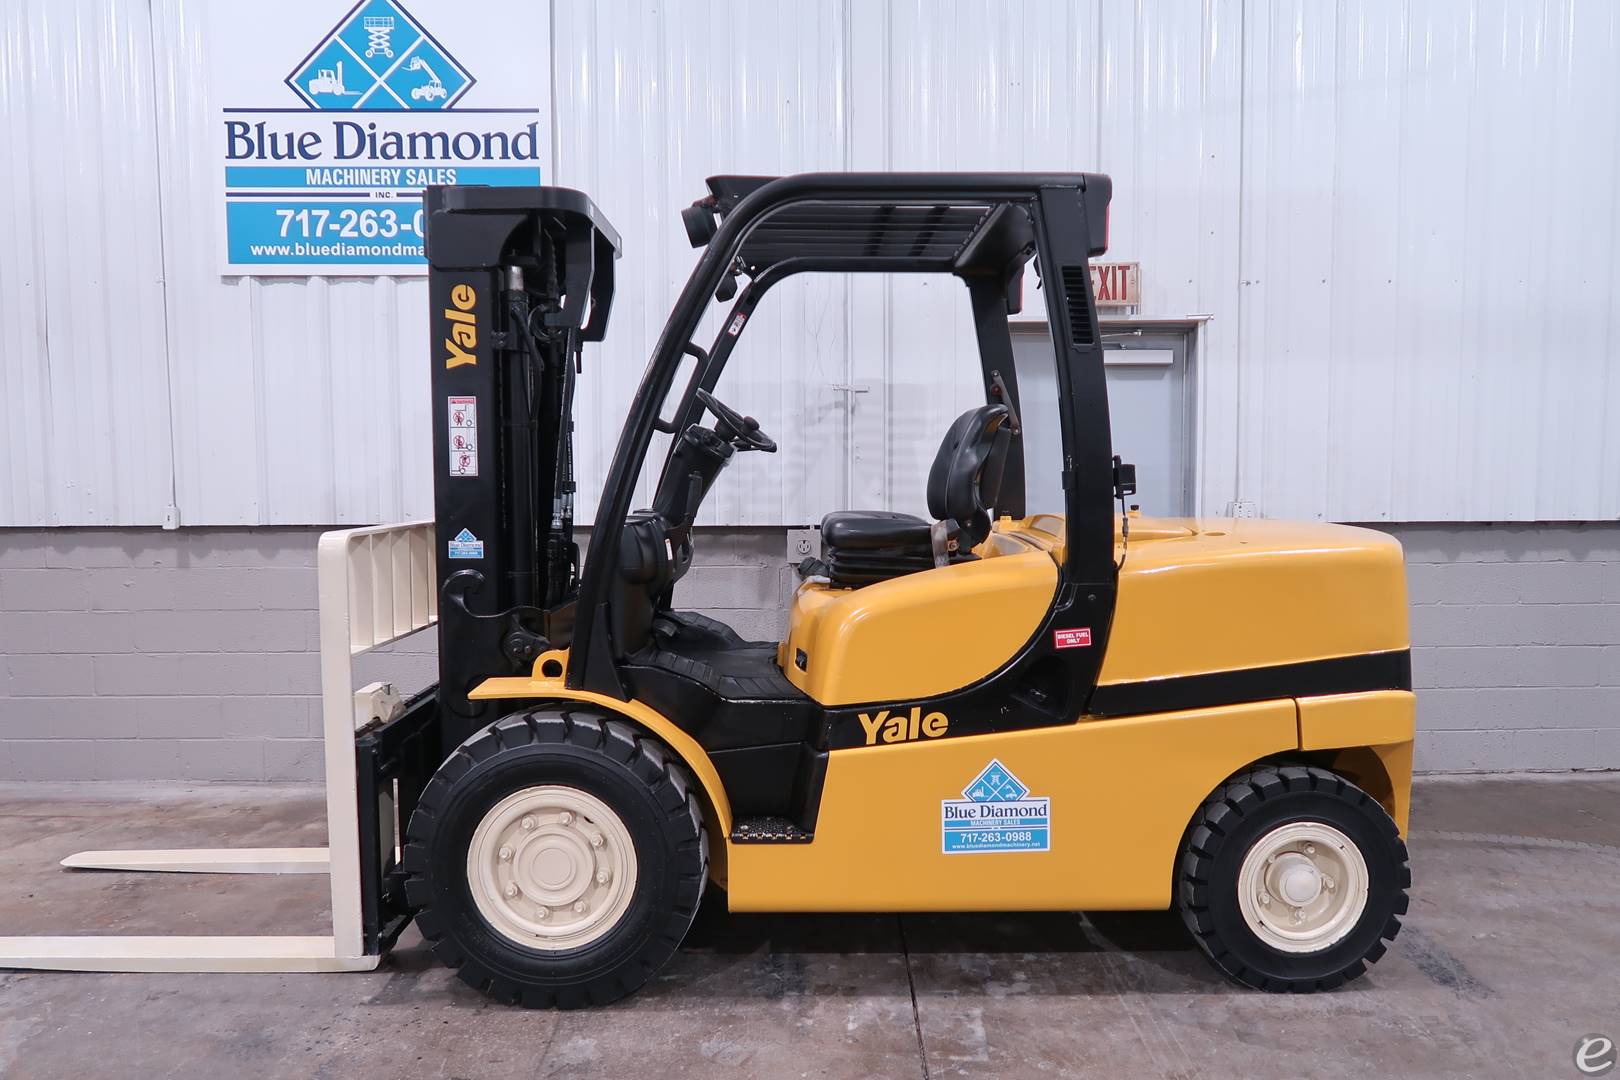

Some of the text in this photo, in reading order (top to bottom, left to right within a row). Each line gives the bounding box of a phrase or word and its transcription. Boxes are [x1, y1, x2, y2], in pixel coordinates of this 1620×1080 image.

[224, 121, 540, 160] Blue Diamond
[306, 168, 457, 186] MACHINERY SALES
[375, 191, 394, 199] INC.
[445, 284, 477, 370] Yale
[858, 706, 949, 745] Yale
[944, 804, 1047, 819] Blue Diamond
[960, 831, 1032, 844] 717-263-0988
